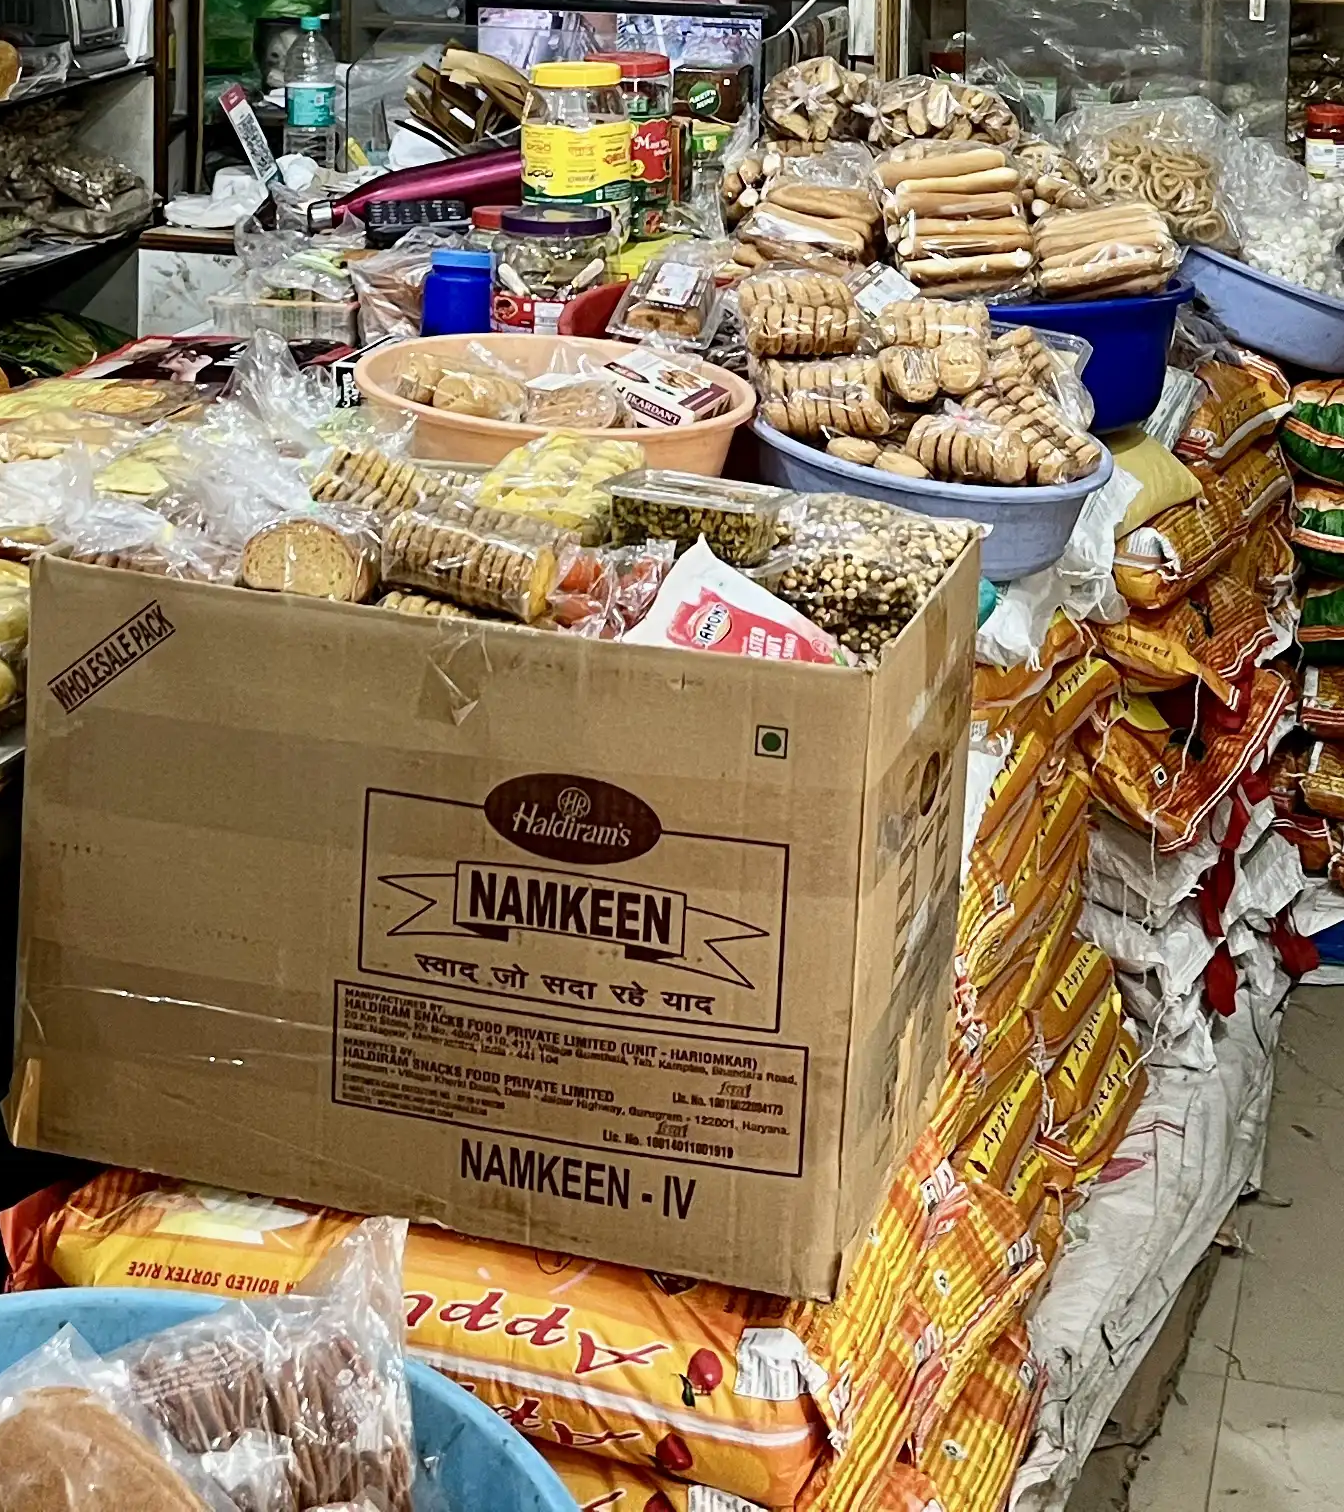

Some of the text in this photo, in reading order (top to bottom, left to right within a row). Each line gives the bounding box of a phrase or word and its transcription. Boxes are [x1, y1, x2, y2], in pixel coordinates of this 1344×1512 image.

[50, 604, 174, 710] WHOLESALE PACK
[1055, 665, 1088, 703] Apple
[512, 801, 632, 848] Haldiram's
[469, 870, 672, 945] NAMKEEN
[345, 988, 425, 1010] MANUFACTURED
[414, 953, 716, 1015] स्वाद जो सदा रहे याद
[1063, 955, 1089, 992] Apple
[344, 997, 410, 1018] HALDIRAM
[414, 1010, 464, 1027] SNACKS
[467, 1018, 502, 1034] FOOD
[505, 1025, 559, 1044] PRIVATE
[563, 1033, 616, 1052] LIMITED
[621, 1041, 657, 1059] (UNIT
[670, 1046, 757, 1072] HARIOMKAR)
[342, 1046, 408, 1067] HALDIRAM
[412, 1058, 462, 1077] SNACKS
[465, 1068, 500, 1084] FOOD
[504, 1074, 556, 1093] PRIVATE
[562, 1084, 614, 1102] LIMITED
[983, 1098, 1013, 1157] Apple
[460, 1138, 630, 1210] NAMKEEN
[663, 1174, 697, 1220] IV
[126, 1261, 279, 1295] BOILED SORTEX RICE
